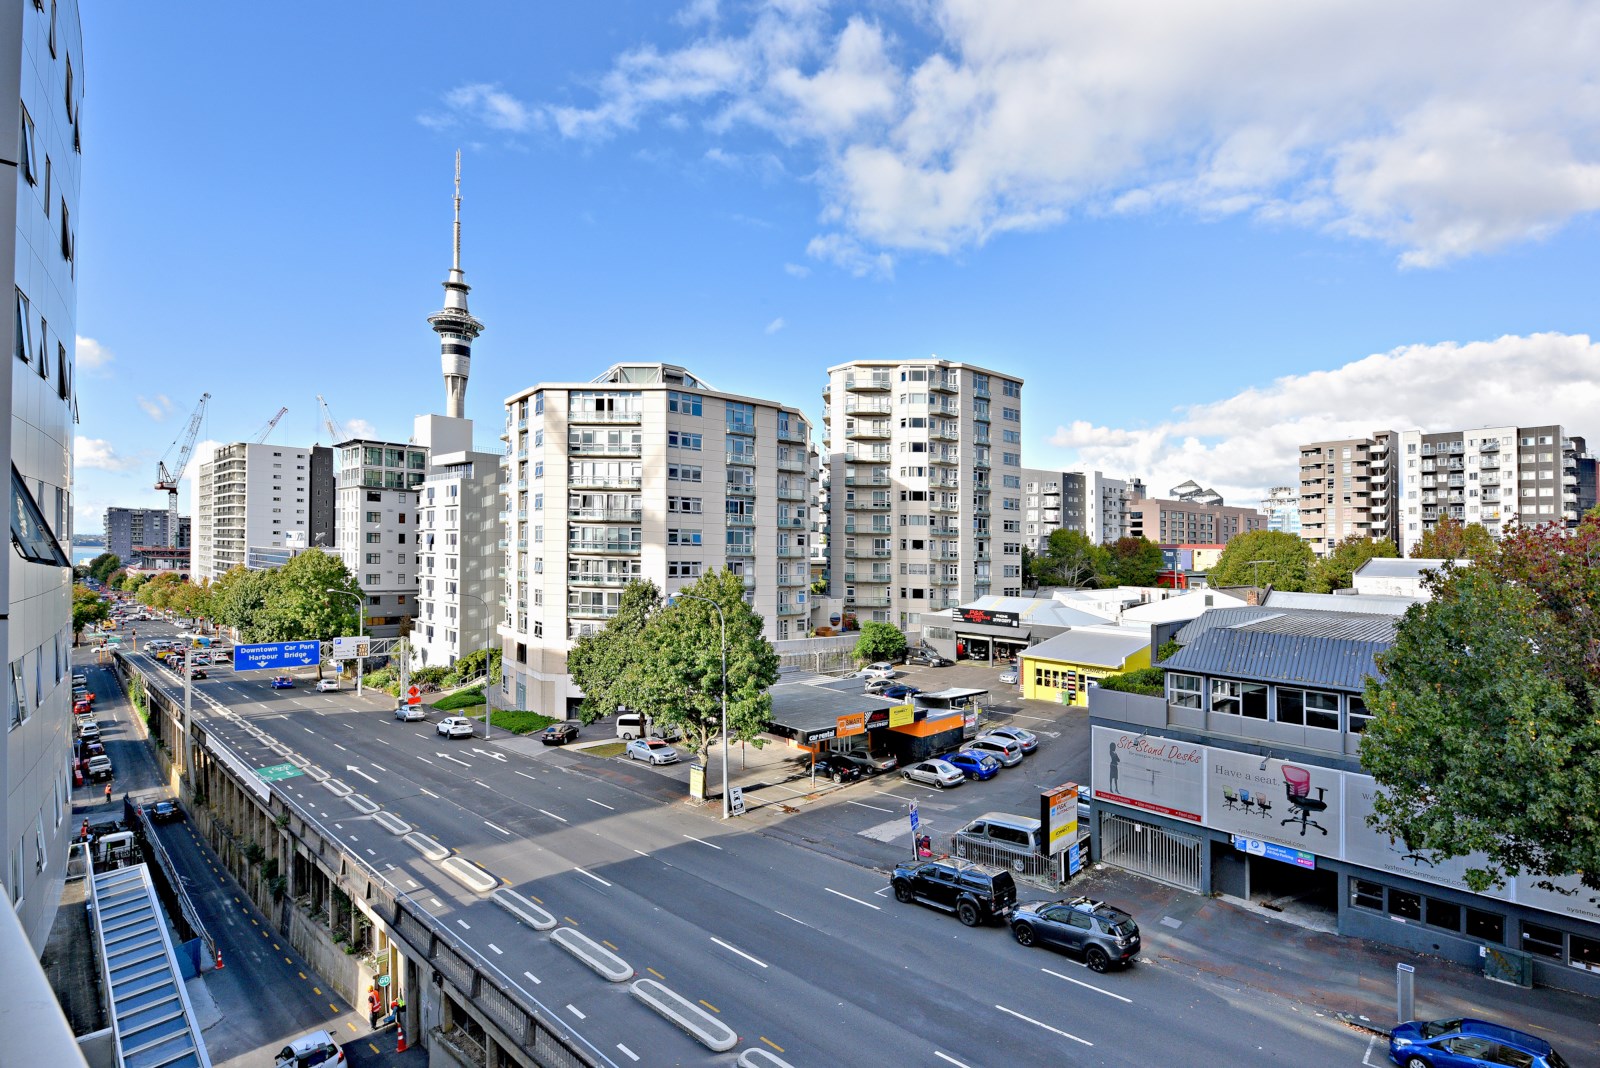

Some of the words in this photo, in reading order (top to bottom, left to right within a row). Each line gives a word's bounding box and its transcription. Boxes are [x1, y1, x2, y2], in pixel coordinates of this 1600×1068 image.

[241, 646, 278, 654] Downtown
[249, 653, 278, 661] Harbour
[284, 651, 307, 659] Bridge
[819, 730, 834, 740] rental
[1168, 745, 1202, 764] Desks
[1215, 764, 1242, 779] Have
[1254, 775, 1281, 787] seat.
[380, 976, 389, 984] GO
